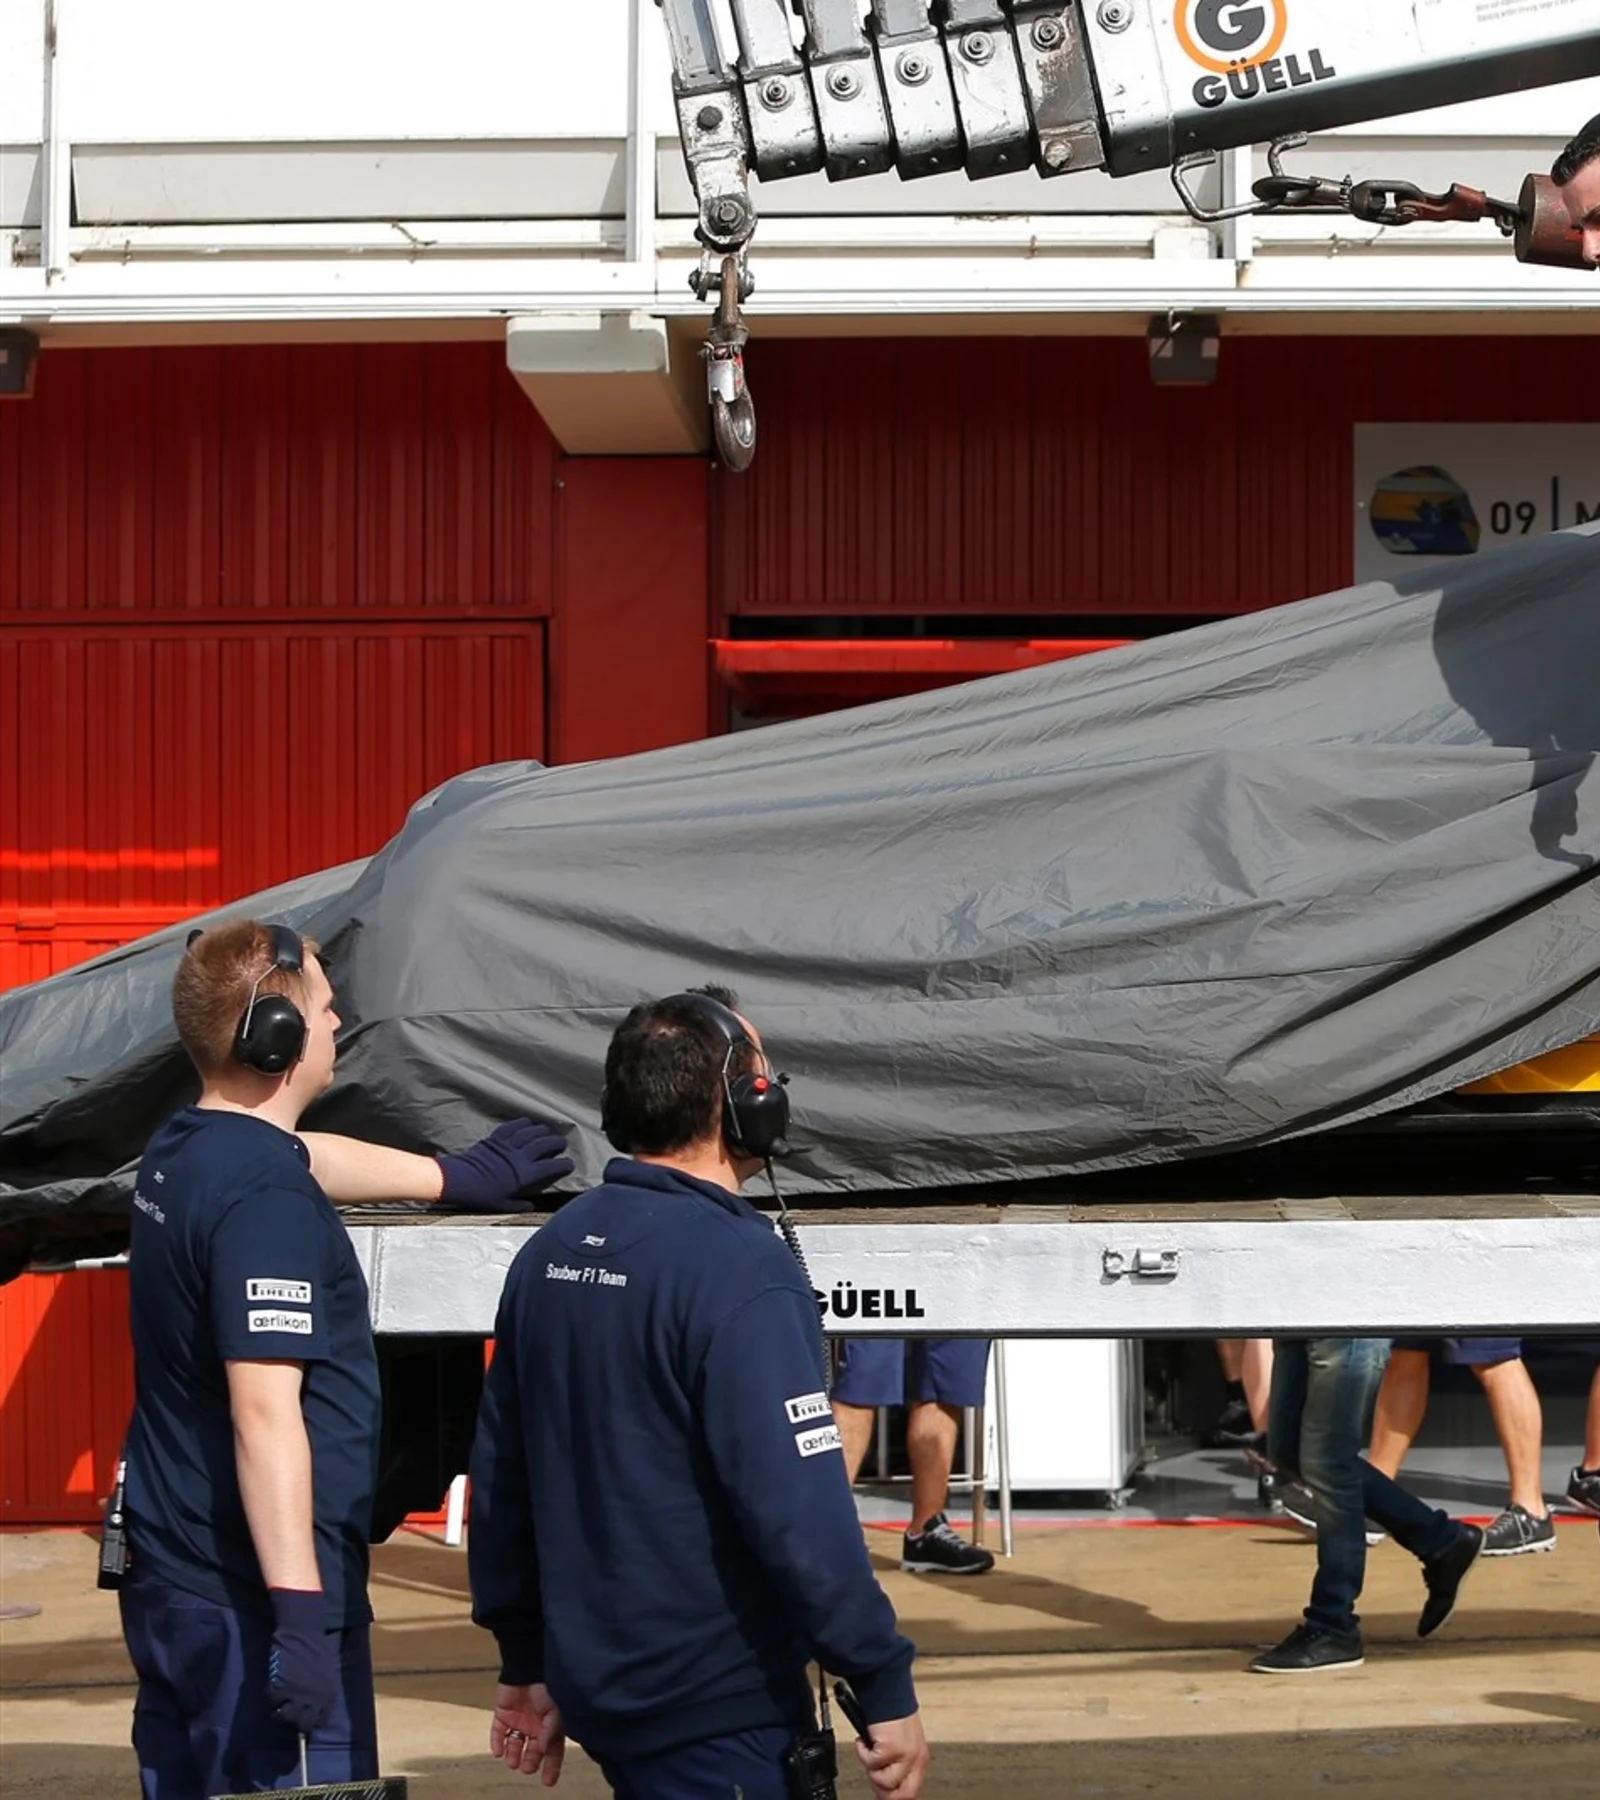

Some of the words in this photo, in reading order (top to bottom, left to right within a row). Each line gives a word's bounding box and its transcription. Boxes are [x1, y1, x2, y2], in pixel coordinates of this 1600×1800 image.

[1192, 48, 1336, 108] GÜELL
[1490, 501, 1536, 534] 09
[546, 1263, 582, 1281] Sauber
[582, 1267, 596, 1283] F1
[597, 1268, 628, 1287] Team
